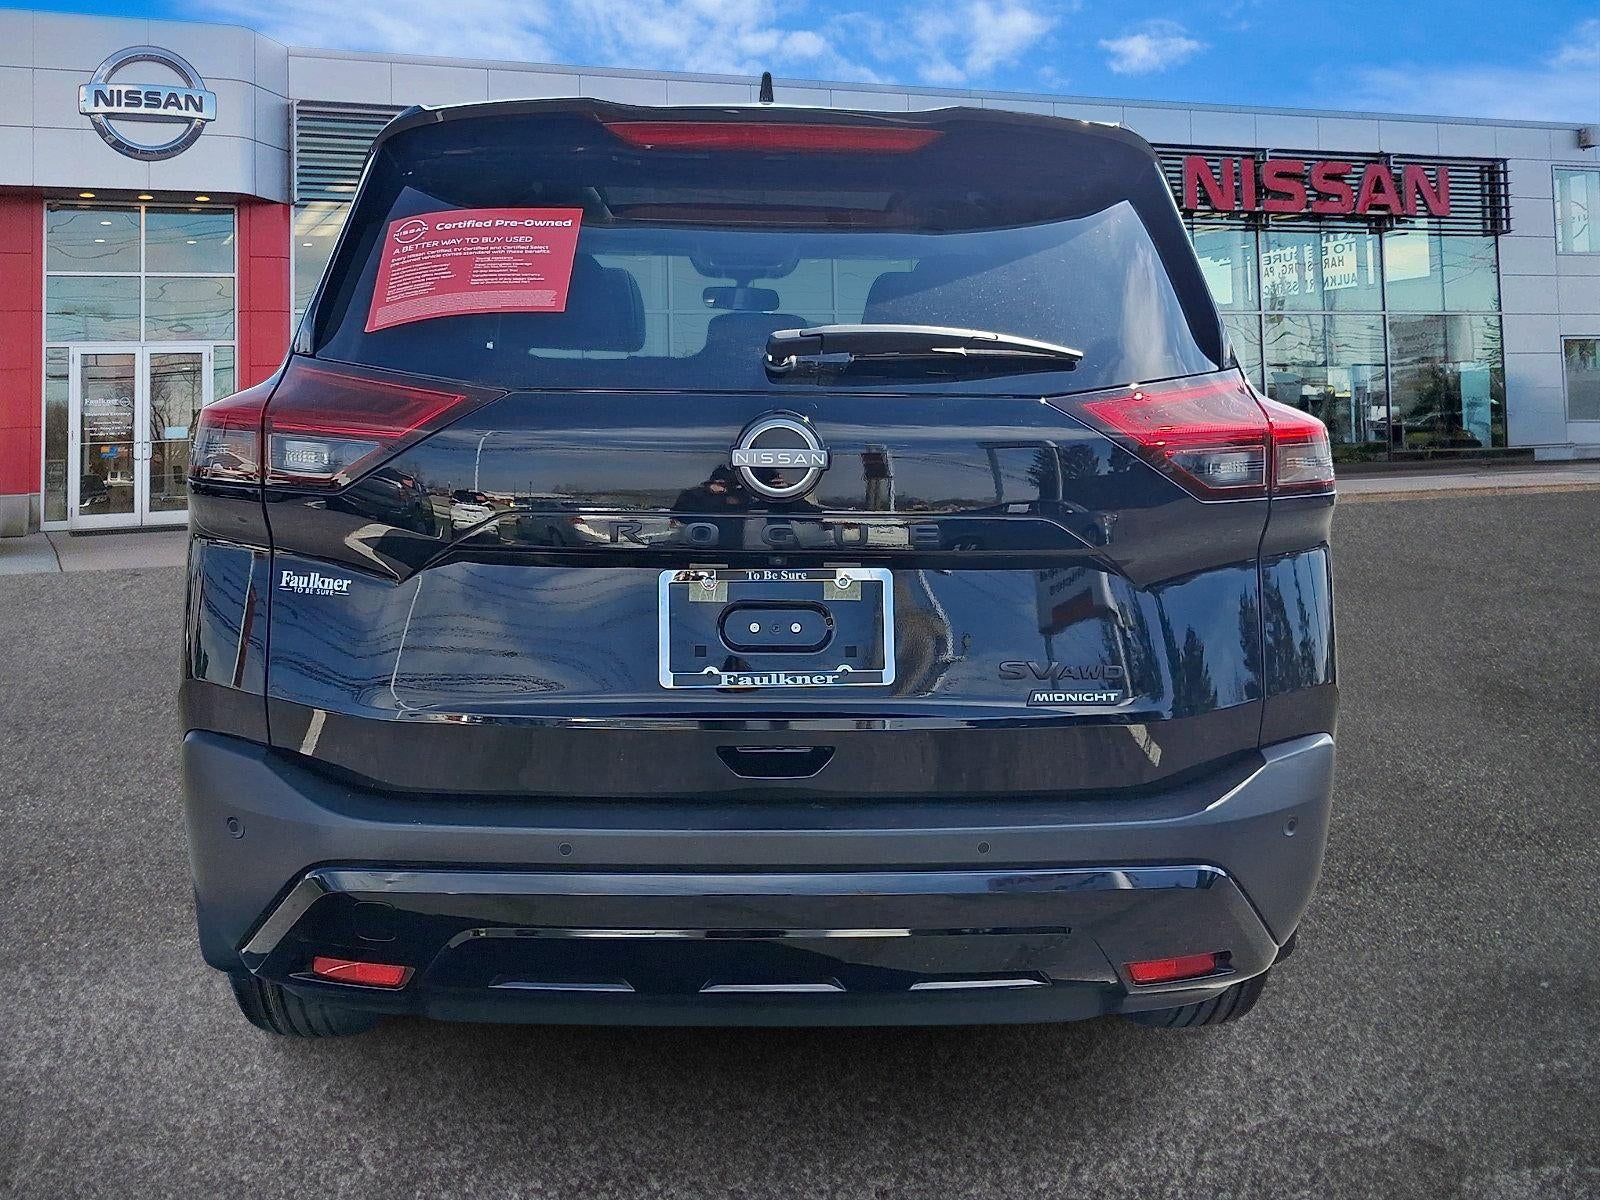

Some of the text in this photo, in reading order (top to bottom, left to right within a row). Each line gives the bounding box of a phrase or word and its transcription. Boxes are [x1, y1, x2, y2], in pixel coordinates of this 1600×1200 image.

[93, 89, 203, 113] NISSAN
[1183, 155, 1451, 217] NISSAN
[393, 225, 429, 238] NISSAN
[435, 219, 573, 231] Certified Pre-Owned
[392, 247, 400, 256] A
[402, 241, 439, 254] BETTER
[441, 238, 463, 246] WAY
[481, 236, 503, 244] BUY
[735, 452, 825, 464] NISSAN
[608, 521, 943, 547] ROGUE
[280, 570, 352, 592] Faulkner
[746, 570, 807, 580] To Be Sure
[305, 587, 314, 595] BE
[316, 588, 335, 596] SURE
[719, 673, 839, 686] Faulkner
[1033, 693, 1118, 702] MIDNIGHT
